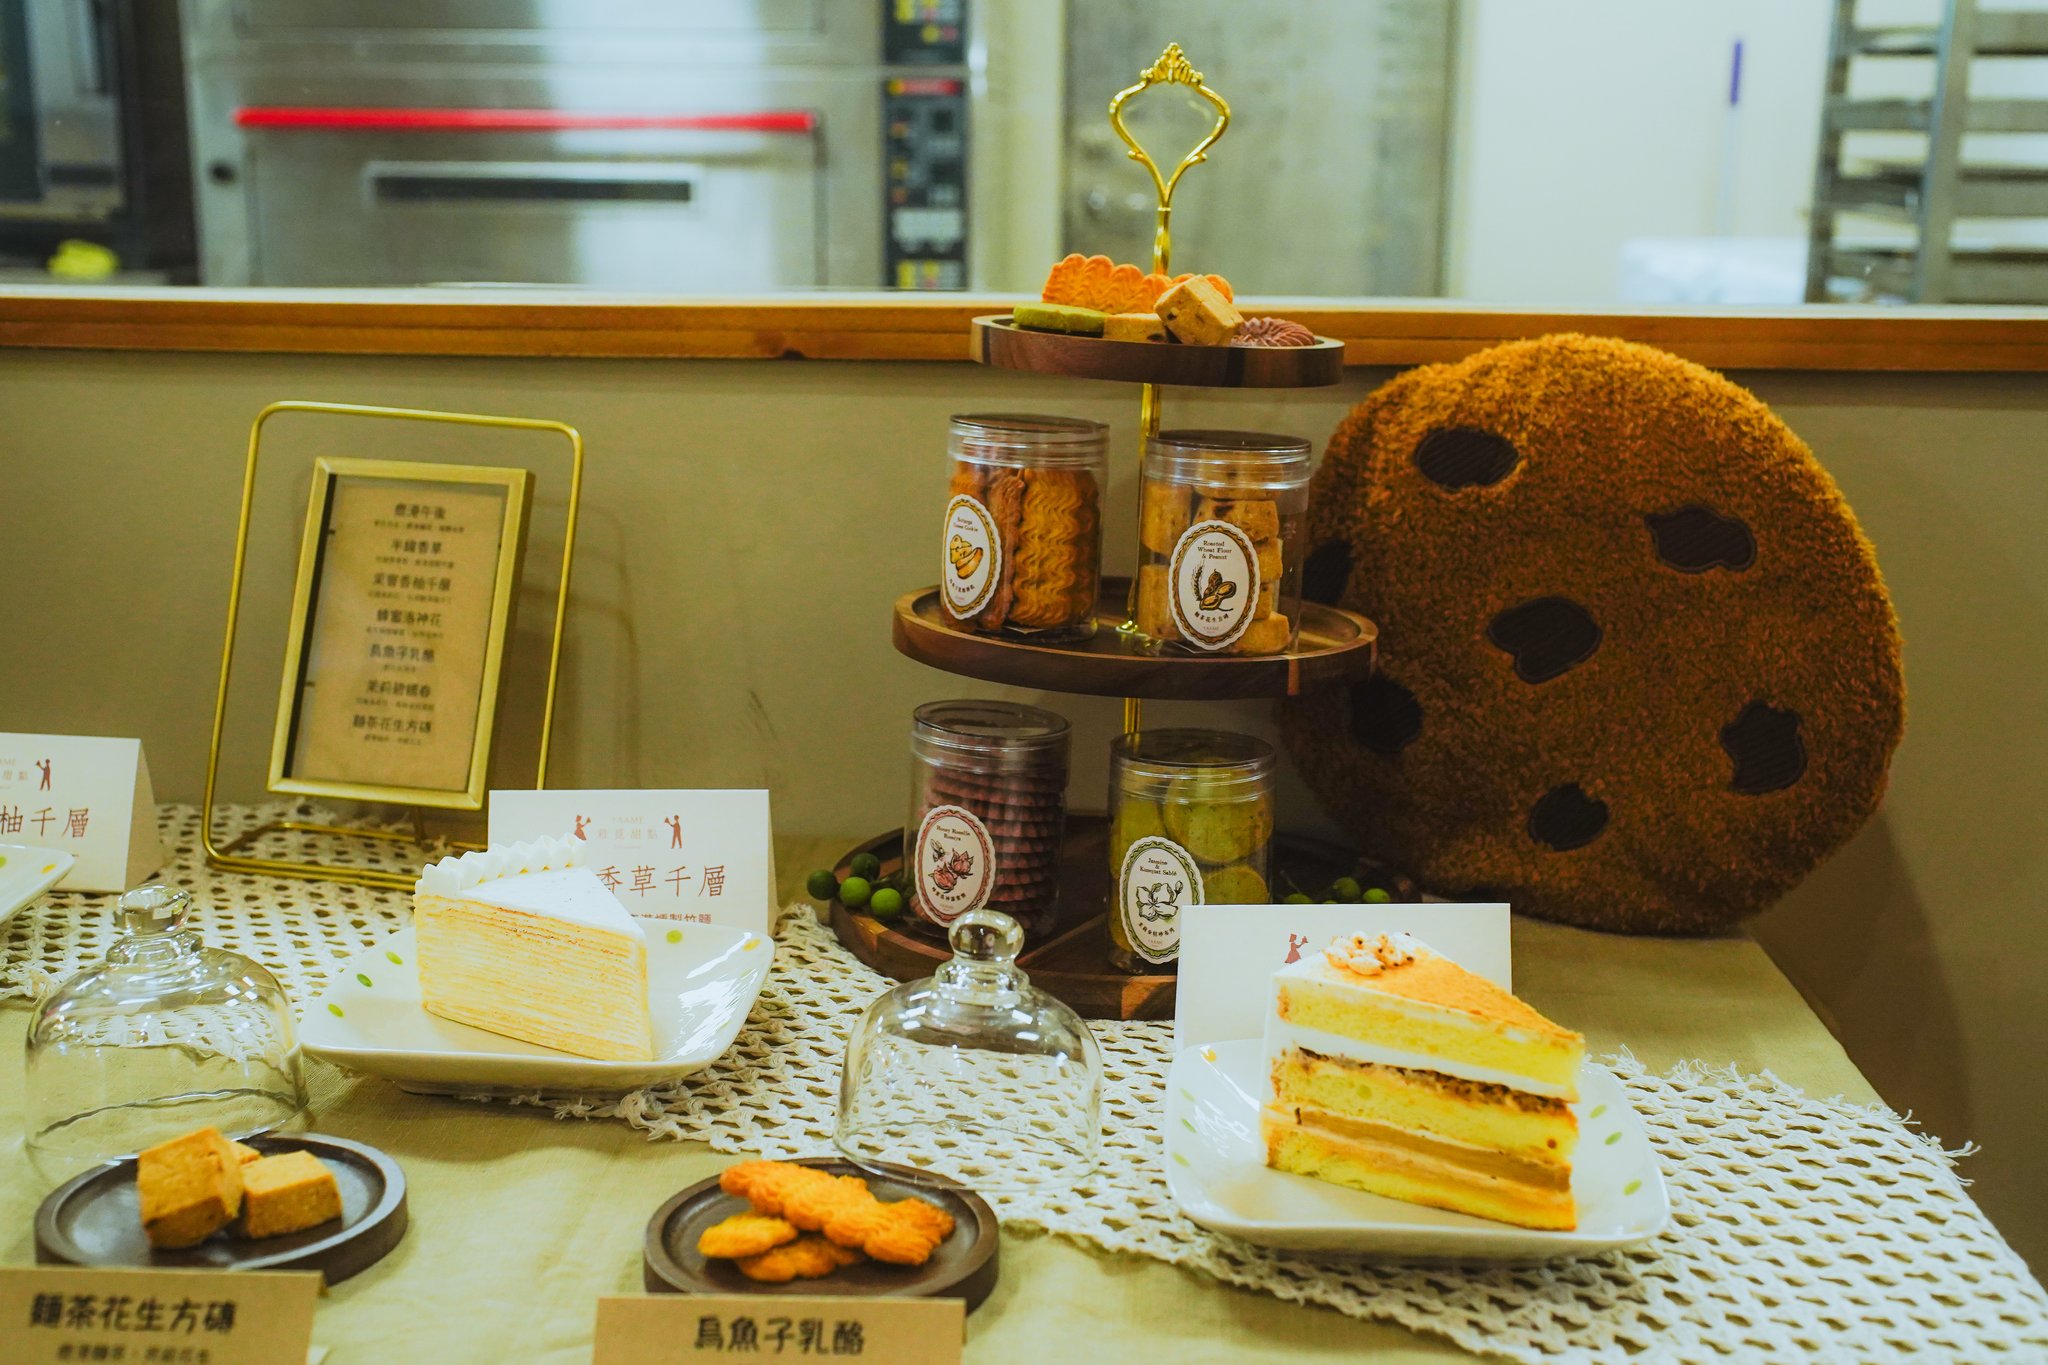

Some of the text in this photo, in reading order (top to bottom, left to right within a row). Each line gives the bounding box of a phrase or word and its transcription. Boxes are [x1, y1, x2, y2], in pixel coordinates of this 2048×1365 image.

[0, 805, 89, 838] 柚千層
[596, 865, 725, 897] 香草千層
[694, 1314, 866, 1356] 烏魚子乳酪
